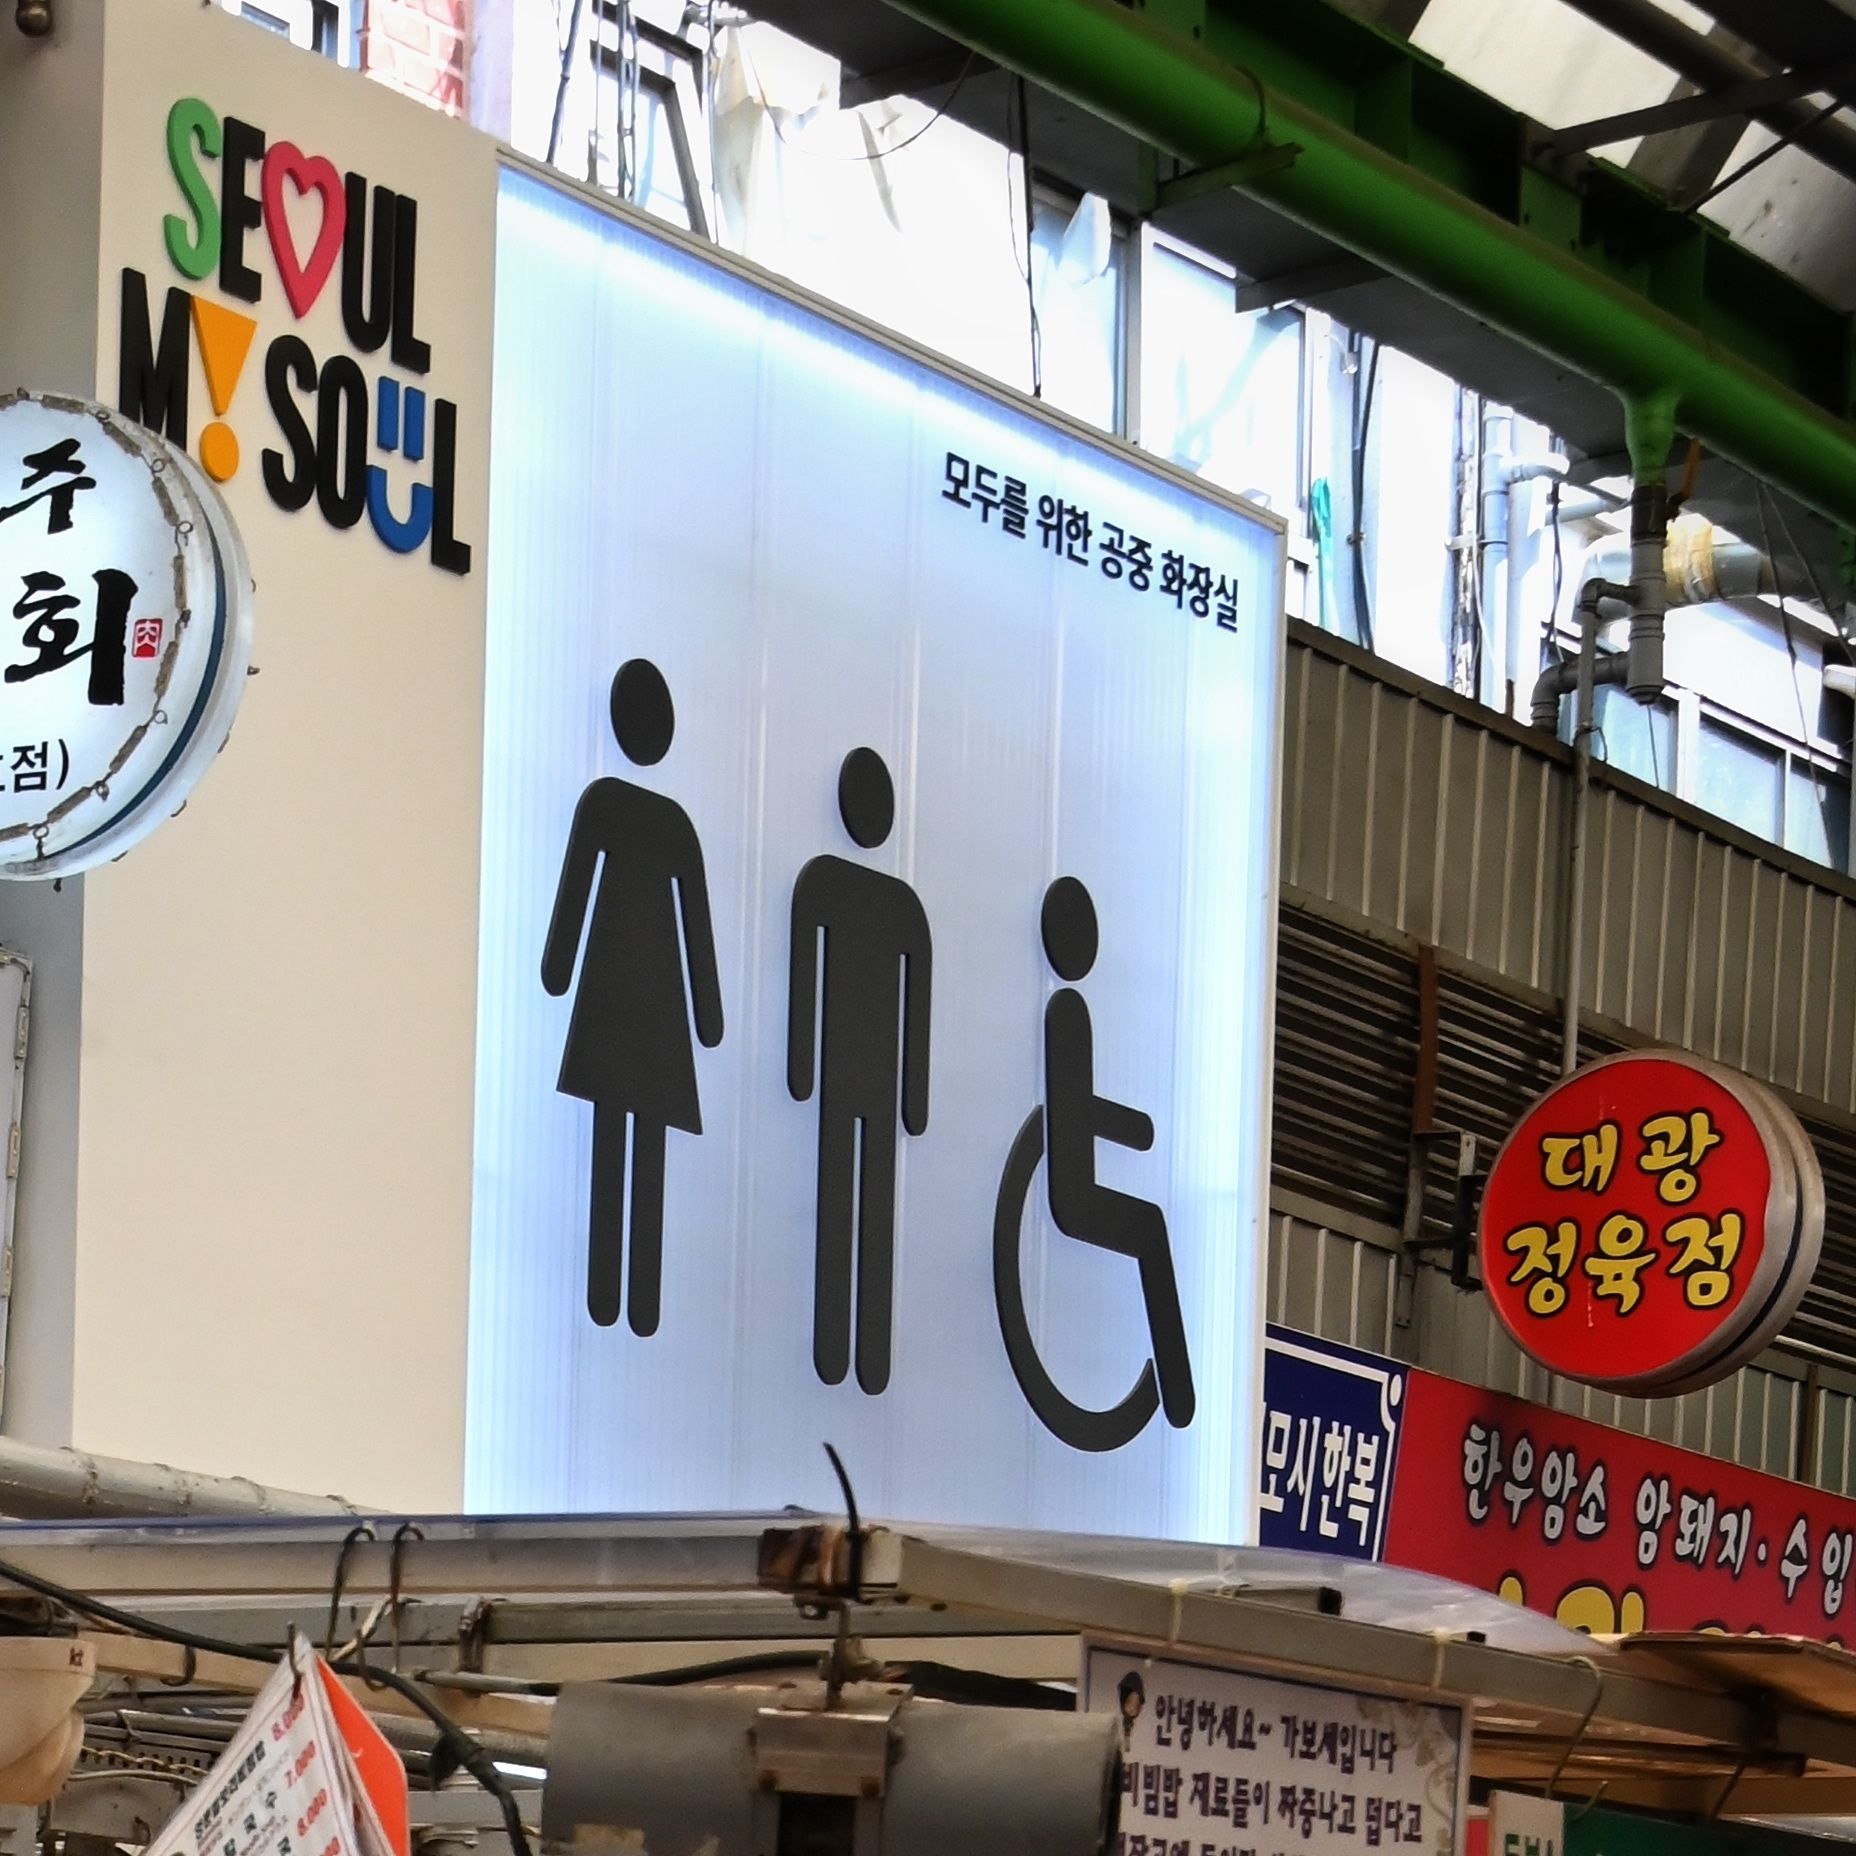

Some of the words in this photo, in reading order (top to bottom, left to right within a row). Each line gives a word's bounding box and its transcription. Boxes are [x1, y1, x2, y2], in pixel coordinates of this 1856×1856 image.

[942, 451, 1029, 539] 모두를
[1036, 494, 1092, 567] 위한
[1099, 522, 1154, 591] 공중
[1160, 549, 1239, 633] 화장실
[1540, 1111, 1723, 1203] 대광
[1505, 1212, 1743, 1315] 정육점
[1462, 1423, 1608, 1540] 한우암소
[1155, 1694, 1273, 1751] 안녕하세요~
[1280, 1714, 1398, 1775] 가보세입니다
[1365, 1796, 1423, 1847] 덥다고
